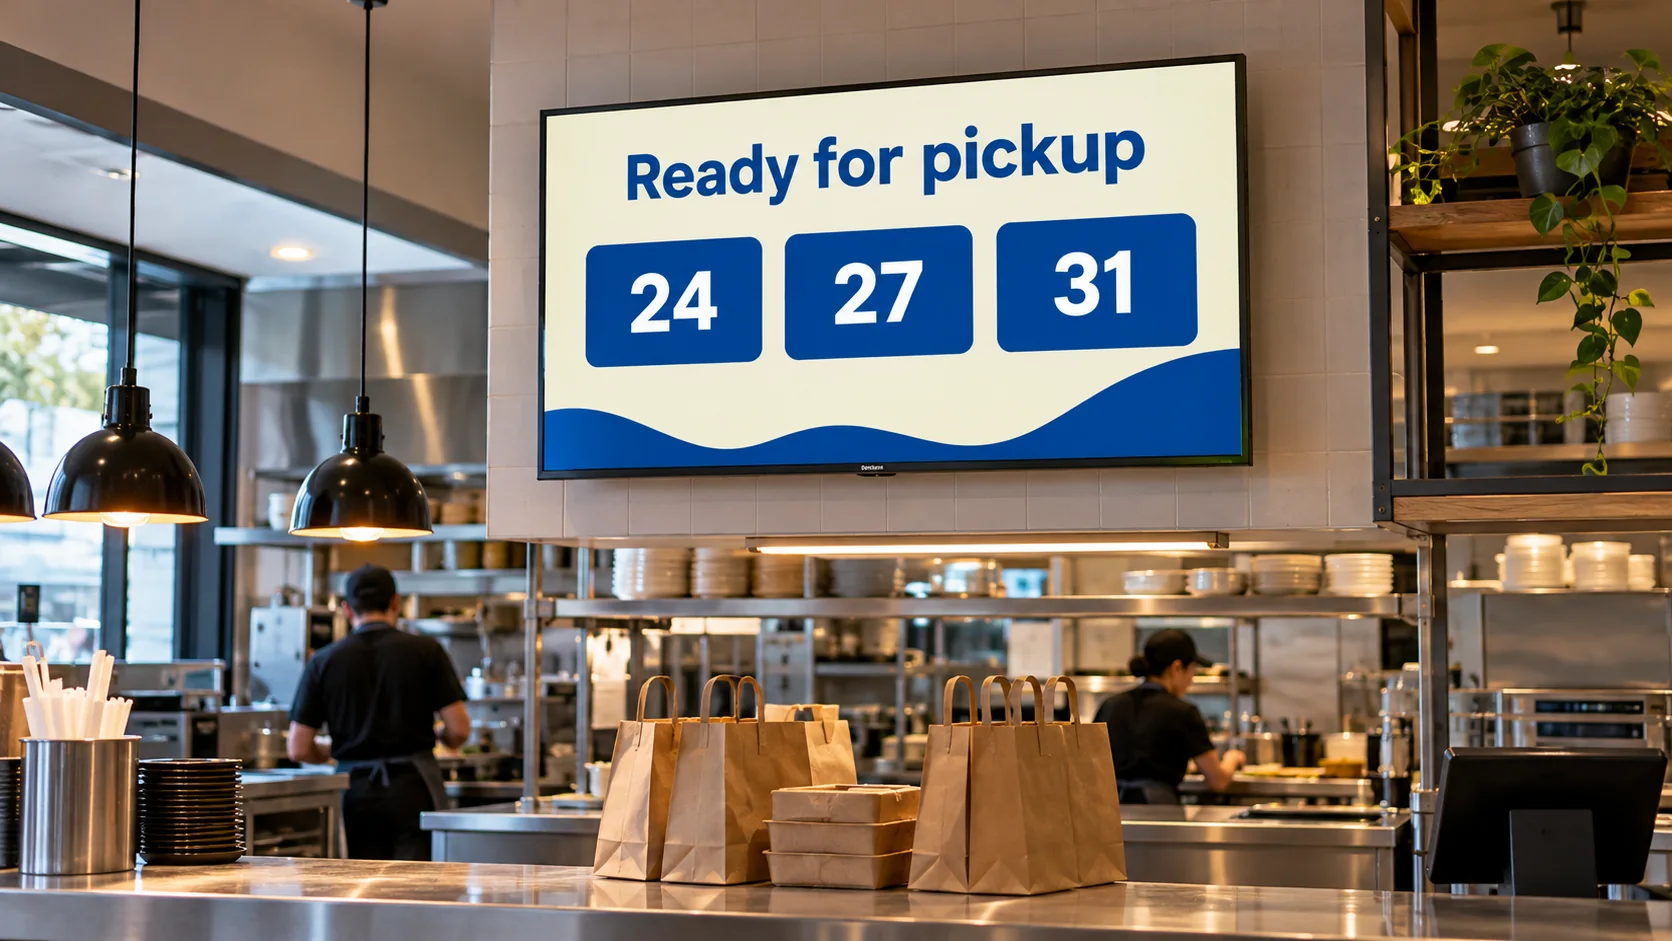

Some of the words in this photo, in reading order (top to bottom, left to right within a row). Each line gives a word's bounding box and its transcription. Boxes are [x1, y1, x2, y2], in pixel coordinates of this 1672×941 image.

[627, 143, 799, 205] Ready
[813, 136, 903, 189] for
[923, 123, 1146, 196] pickup
[630, 270, 718, 334] 24
[834, 259, 923, 325] 27
[1054, 249, 1132, 317] 31
